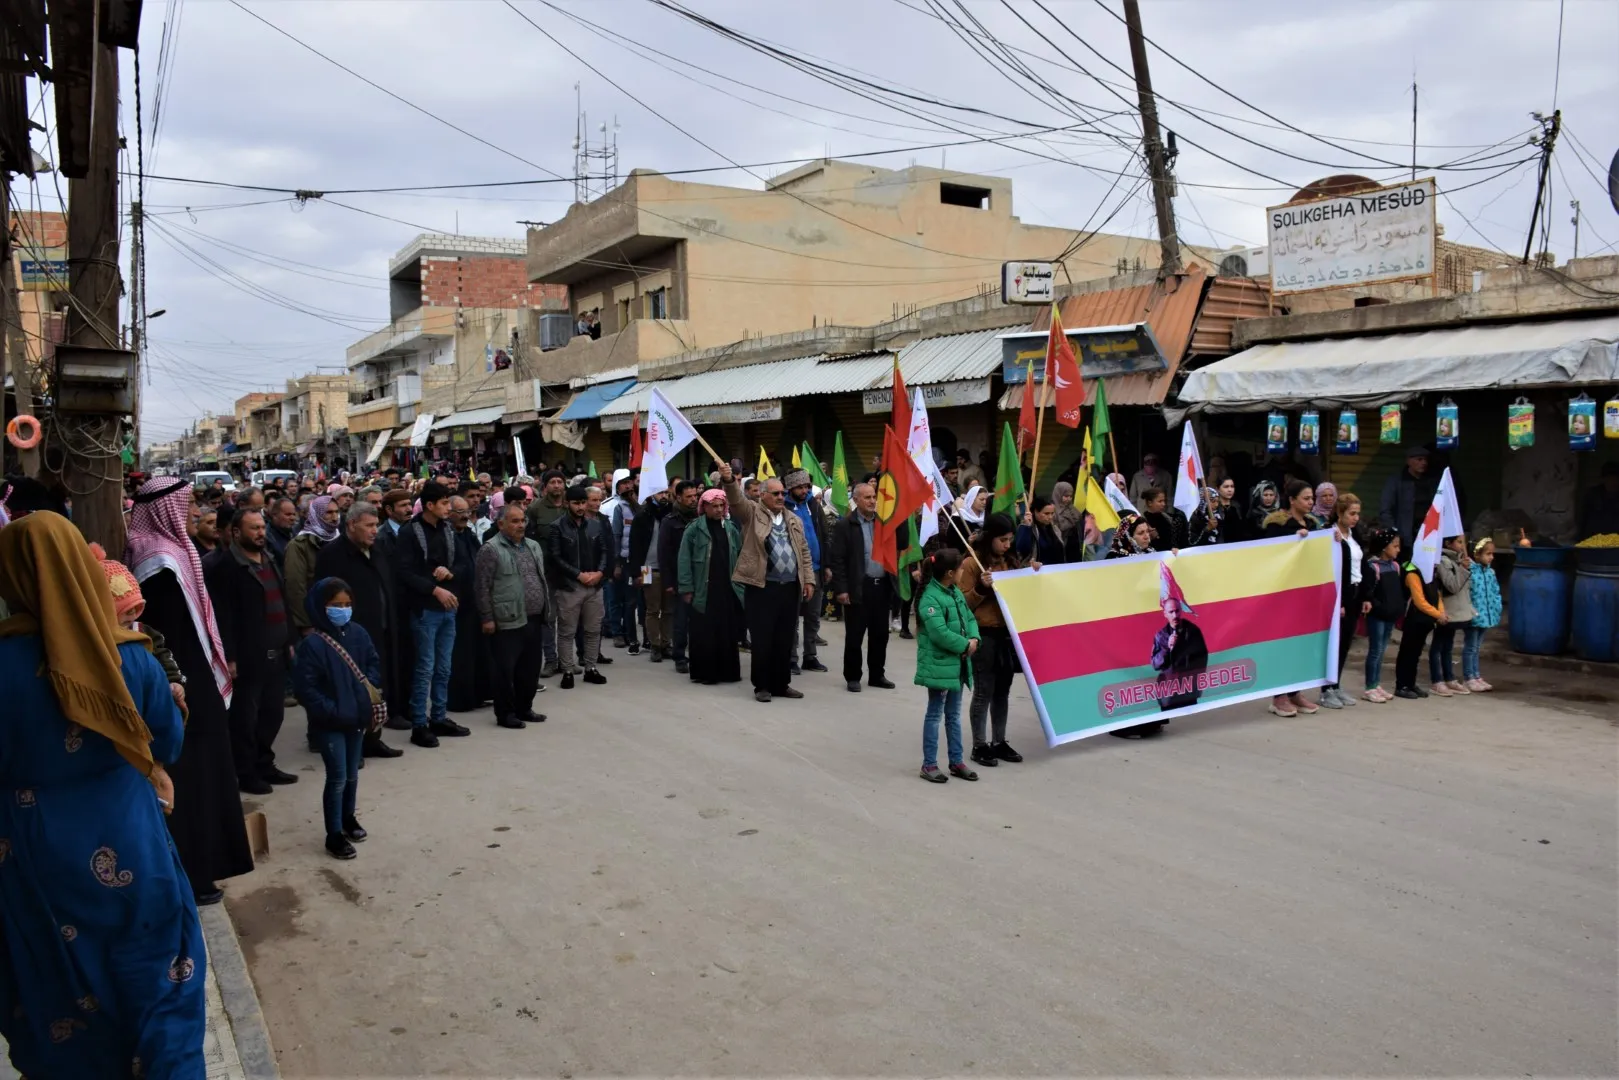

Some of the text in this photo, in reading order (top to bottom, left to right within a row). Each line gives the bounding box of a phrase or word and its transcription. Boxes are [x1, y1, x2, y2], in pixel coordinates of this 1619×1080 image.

[1361, 187, 1425, 214] MESÛD
[1023, 265, 1052, 282] صيدلية
[1023, 283, 1050, 298] ياسر
[1104, 664, 1252, 713] Ş.MERWAN BEDEL
